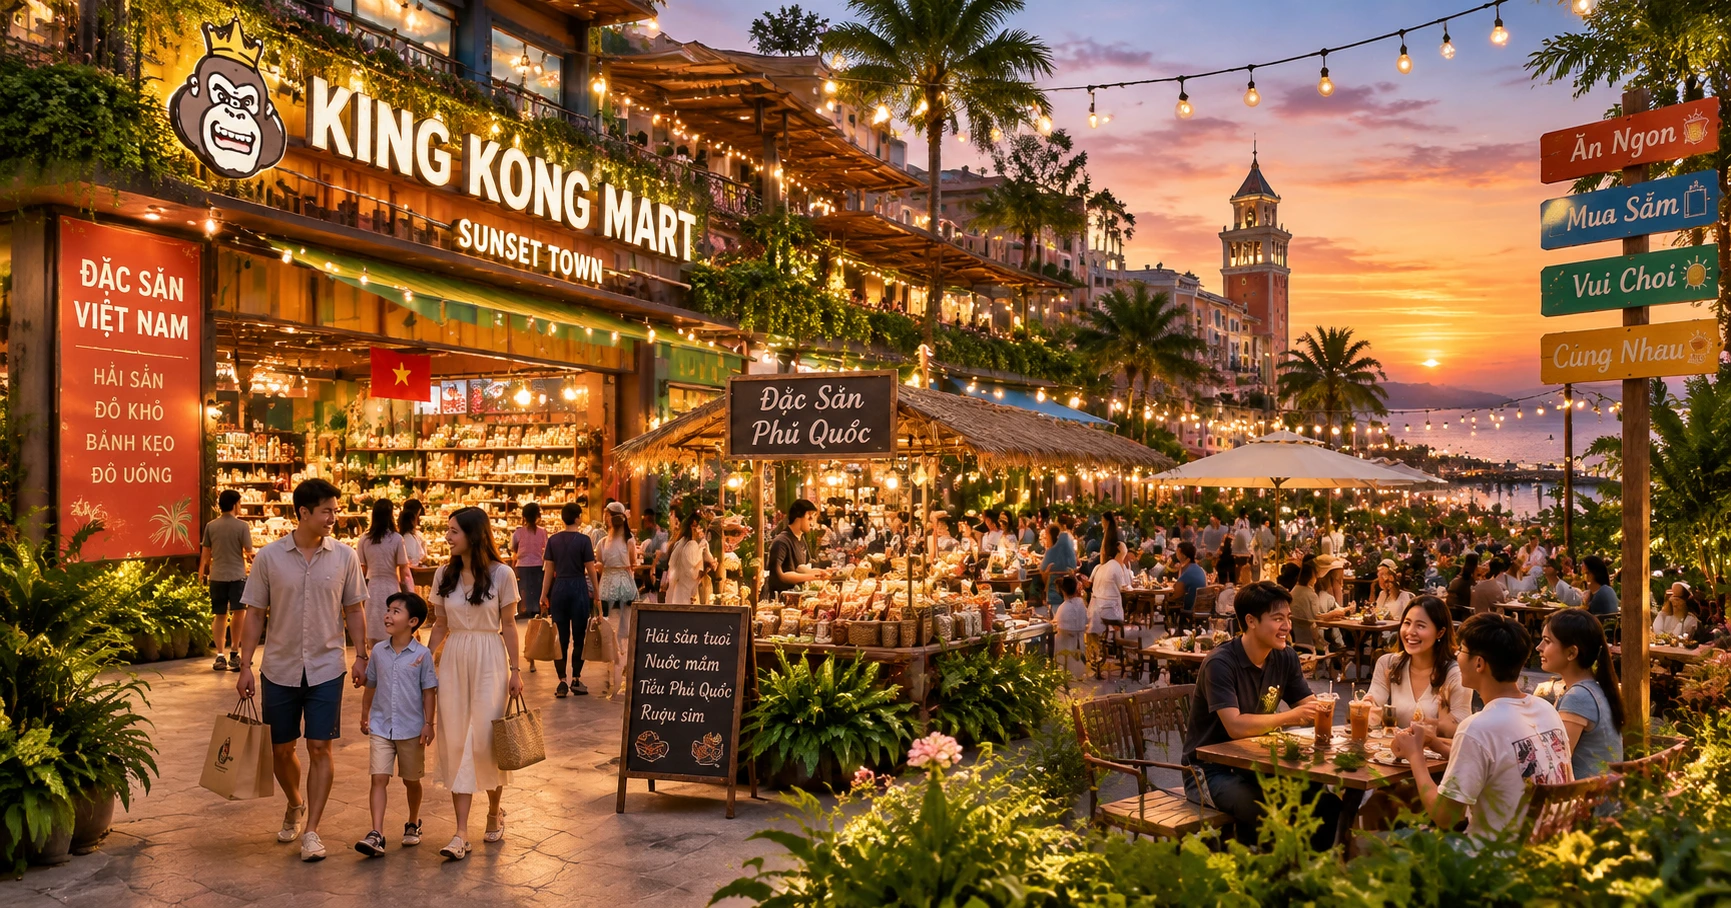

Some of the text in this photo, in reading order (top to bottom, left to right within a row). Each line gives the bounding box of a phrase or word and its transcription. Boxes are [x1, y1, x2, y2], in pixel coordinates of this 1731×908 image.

[1570, 126, 1677, 162] Ăn Ngon
[307, 75, 697, 262] KING KONG MART
[1567, 204, 1618, 232] Mua
[458, 218, 603, 284] SUNSET TOWN
[79, 255, 131, 296] ĐẶC
[1572, 271, 1612, 298] Vui
[73, 298, 189, 340] VIỆT NAM
[1620, 336, 1686, 364] Nhau
[142, 434, 175, 457] KẸO
[681, 707, 706, 723] sim
